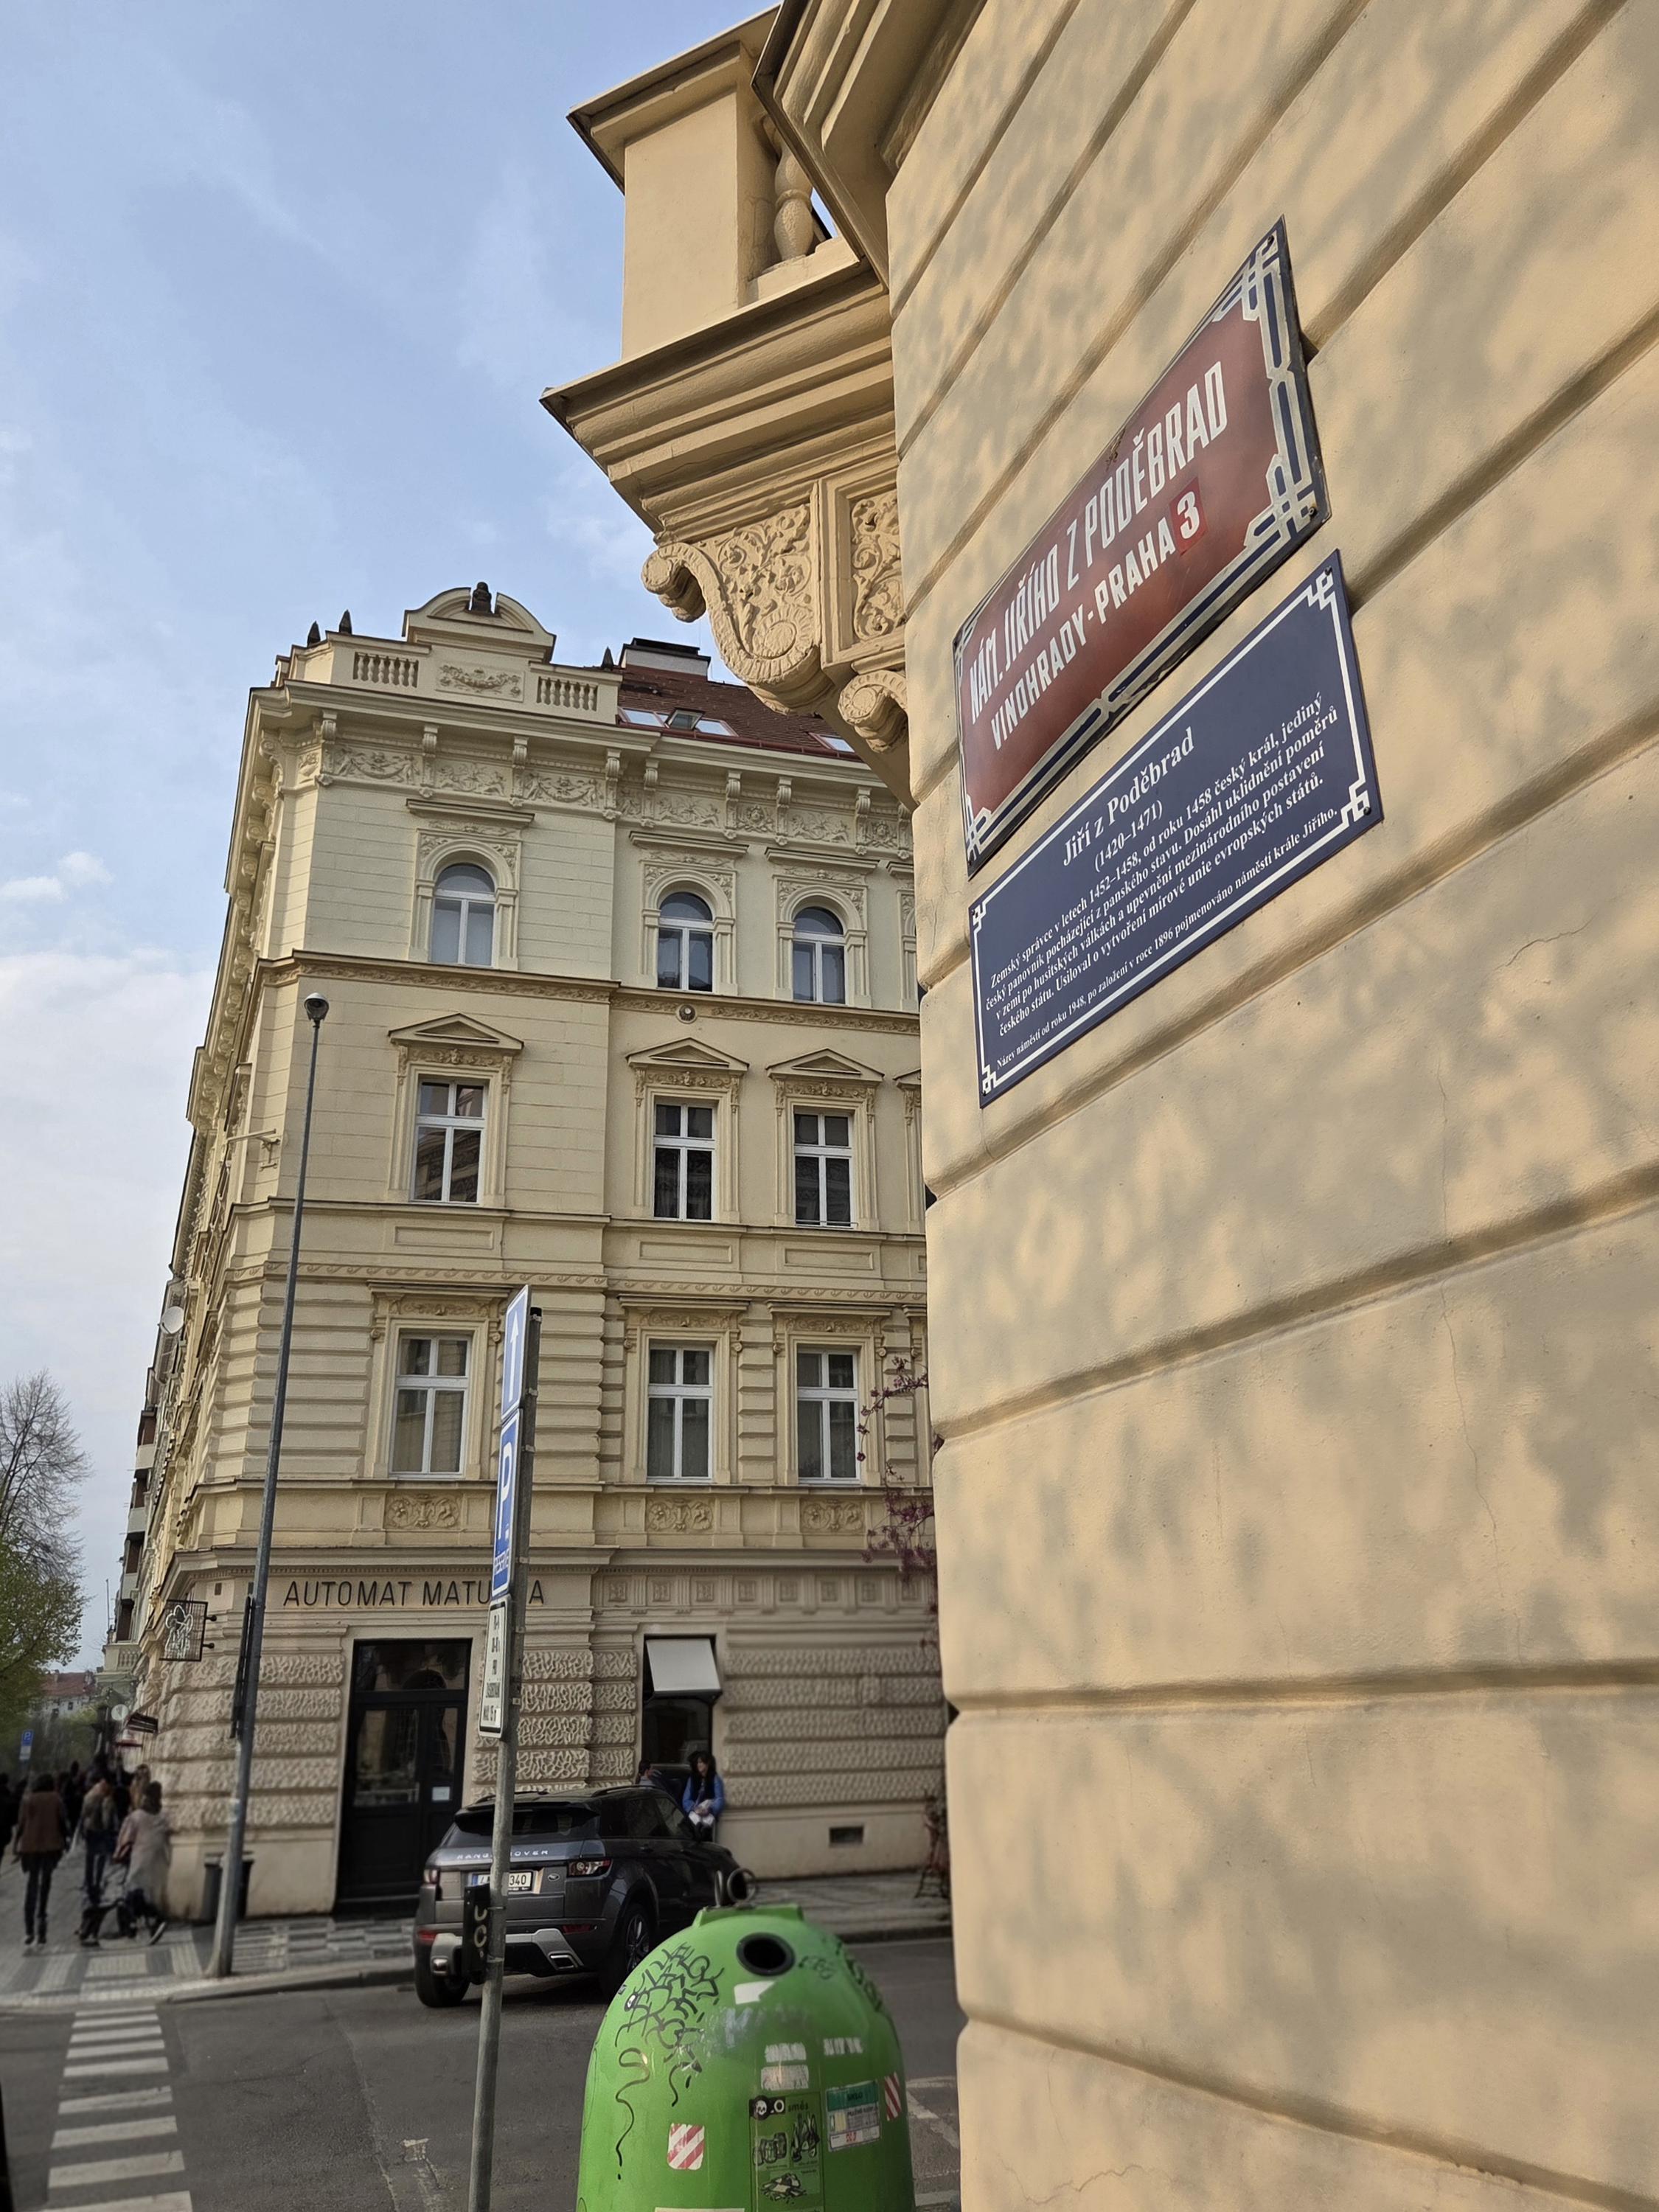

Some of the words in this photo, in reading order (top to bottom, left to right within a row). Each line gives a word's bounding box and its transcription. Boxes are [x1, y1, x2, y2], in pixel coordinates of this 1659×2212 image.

[970, 627, 1004, 725] NÁM.
[1004, 543, 1060, 672] JIŘÍHO
[1066, 519, 1079, 591] Z
[1085, 361, 1228, 568] PODĚBRAD
[1177, 490, 1200, 540] 3
[985, 983, 1007, 1012] český
[1006, 953, 1046, 998] panovník
[1045, 908, 1095, 965] pocházející
[1095, 906, 1102, 920] z
[1102, 867, 1150, 917] panského
[1150, 841, 1183, 874] stavu.
[1183, 800, 1224, 846] Dosáhl
[1224, 748, 1284, 811] uklidnění
[1284, 704, 1338, 765] poměrů
[990, 952, 1021, 990] Zemský
[1021, 928, 1054, 963] správce
[1054, 921, 1060, 933] v
[1060, 897, 1088, 928] letech
[1089, 850, 1142, 904] 1452–1458,
[1142, 835, 1157, 858] od
[1158, 815, 1184, 845] roku
[1185, 787, 1213, 821] 1458
[1214, 757, 1246, 797] český
[1247, 732, 1280, 768] král,
[1281, 690, 1323, 745] jediný
[995, 1009, 1002, 1021] v
[1001, 990, 1022, 1018] zemi
[1021, 984, 1033, 1004] po
[1033, 944, 1079, 991] husitských
[1079, 914, 1117, 952] válkách
[1117, 908, 1125, 922] a
[1125, 864, 1173, 915] upevnění
[1174, 798, 1260, 876] mezinárodního
[1262, 739, 1325, 810] postavení
[998, 1006, 1031, 1037] českého
[1030, 987, 1055, 1012] státu.
[1054, 952, 1092, 992] Usiloval
[1092, 950, 1100, 963] o
[1099, 907, 1147, 957] vytvoření
[1148, 877, 1186, 919] mírové
[1186, 860, 1213, 888] unie
[1214, 801, 1284, 866] evropských
[1284, 771, 1324, 810] států.
[1062, 821, 1092, 867] Jiří
[1093, 815, 1105, 839] z
[1106, 725, 1195, 827] Poděbrad
[1094, 799, 1164, 874] (1420–1471)
[996, 1049, 1016, 1071] Název
[1015, 1027, 1041, 1056] náměstí
[1040, 1020, 1051, 1037] od
[1050, 1010, 1068, 1030] roku
[1068, 994, 1088, 1016] 1948,
[1087, 987, 1098, 1005] po
[1097, 960, 1129, 994] založení
[1128, 959, 1135, 969] v
[1135, 945, 1153, 965] roce
[1153, 927, 1175, 950] 1896
[1174, 884, 1234, 939] pojmenováno
[1234, 850, 1273, 890] náměstí
[1273, 833, 1301, 860] krále
[1301, 807, 1338, 839] Jiřího.
[283, 1580, 412, 1607] AUTOMAT
[422, 1579, 545, 1607] MATUA
